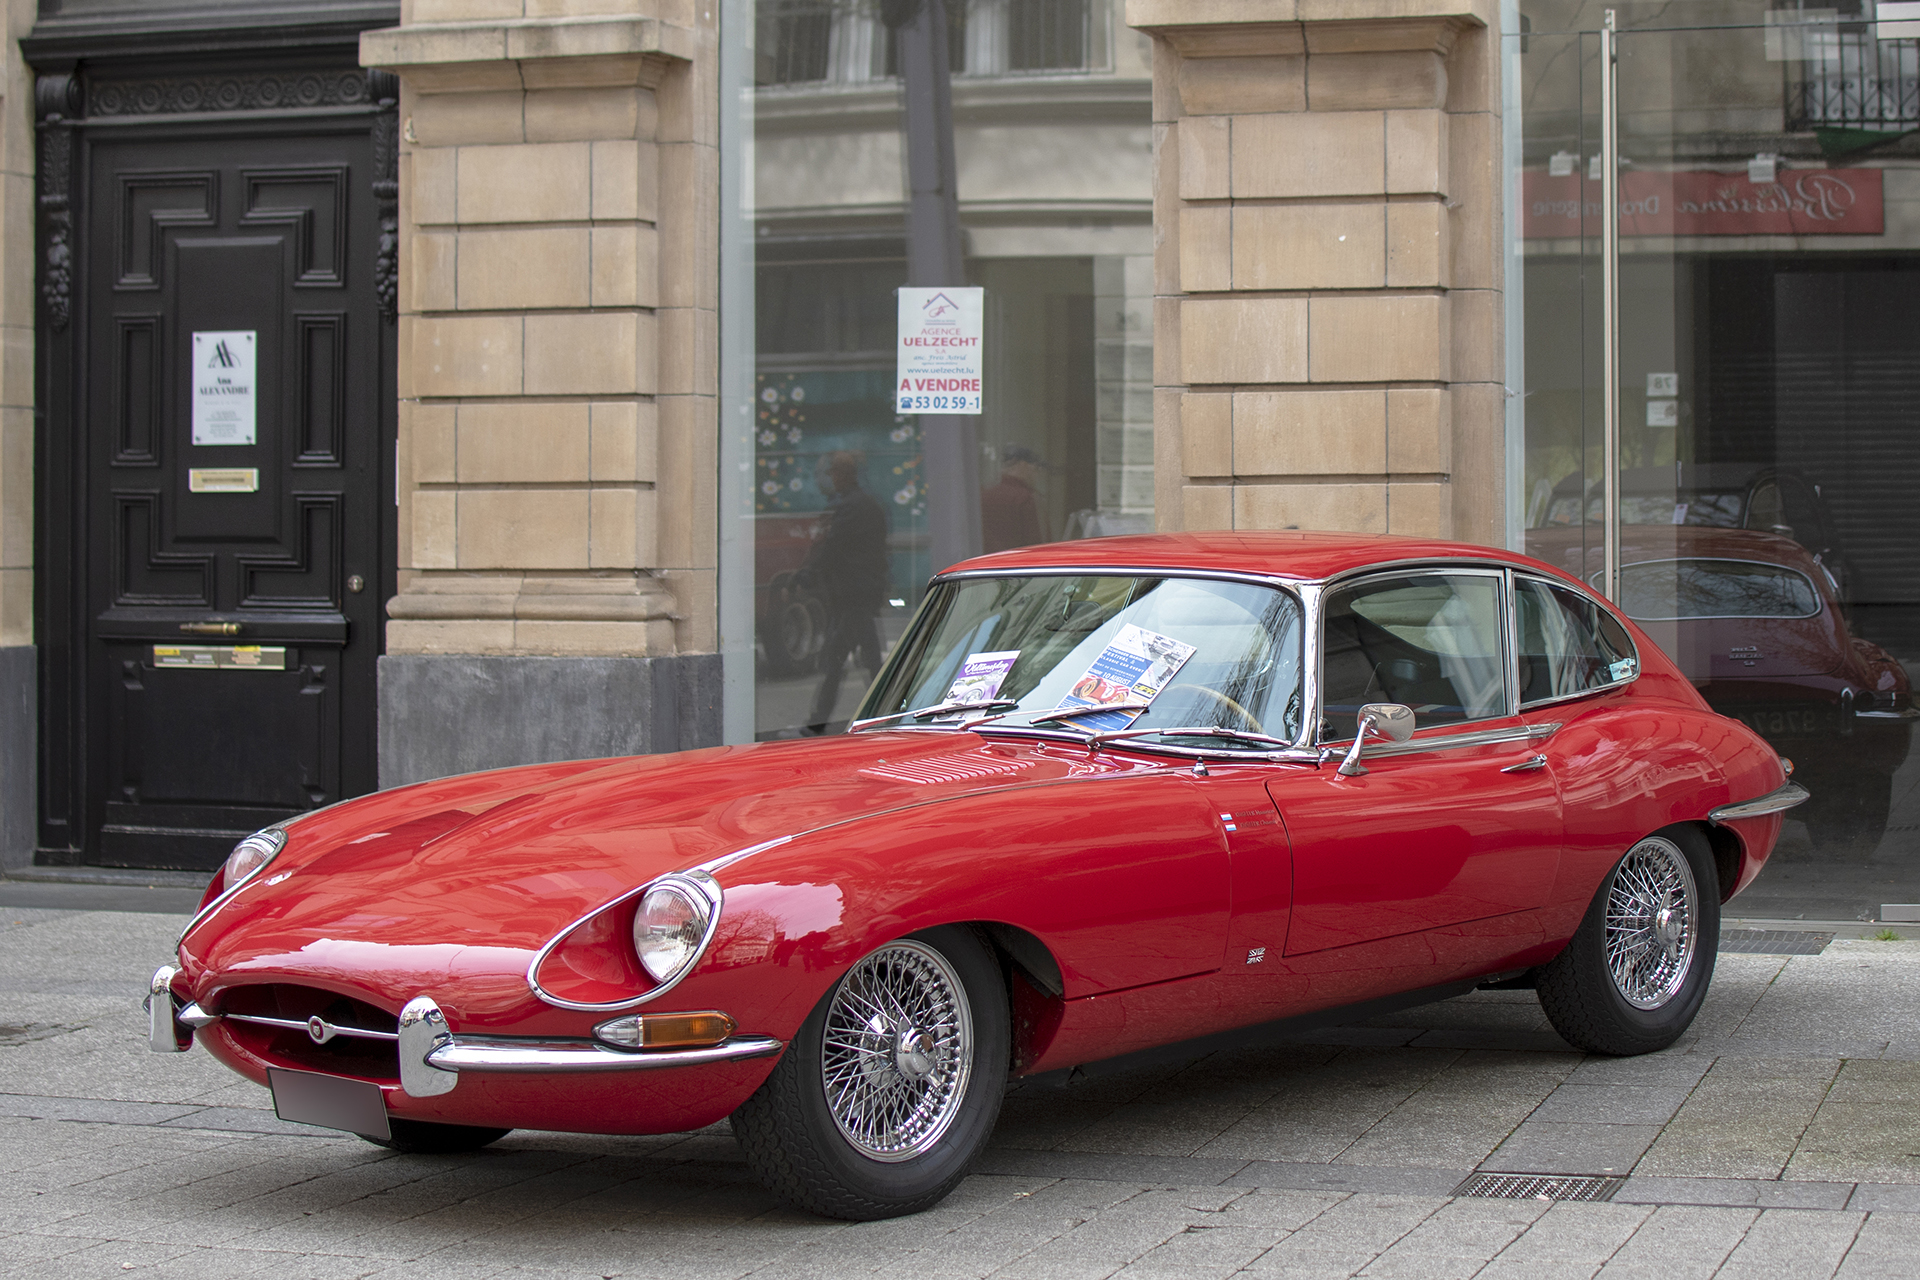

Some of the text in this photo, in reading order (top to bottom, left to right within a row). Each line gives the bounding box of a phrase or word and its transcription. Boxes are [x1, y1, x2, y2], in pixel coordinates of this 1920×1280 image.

[903, 337, 978, 347] UELZECHT
[900, 379, 980, 391] A VENDRE
[915, 396, 930, 409] 53
[933, 396, 948, 409] 02
[951, 396, 966, 409] 59
